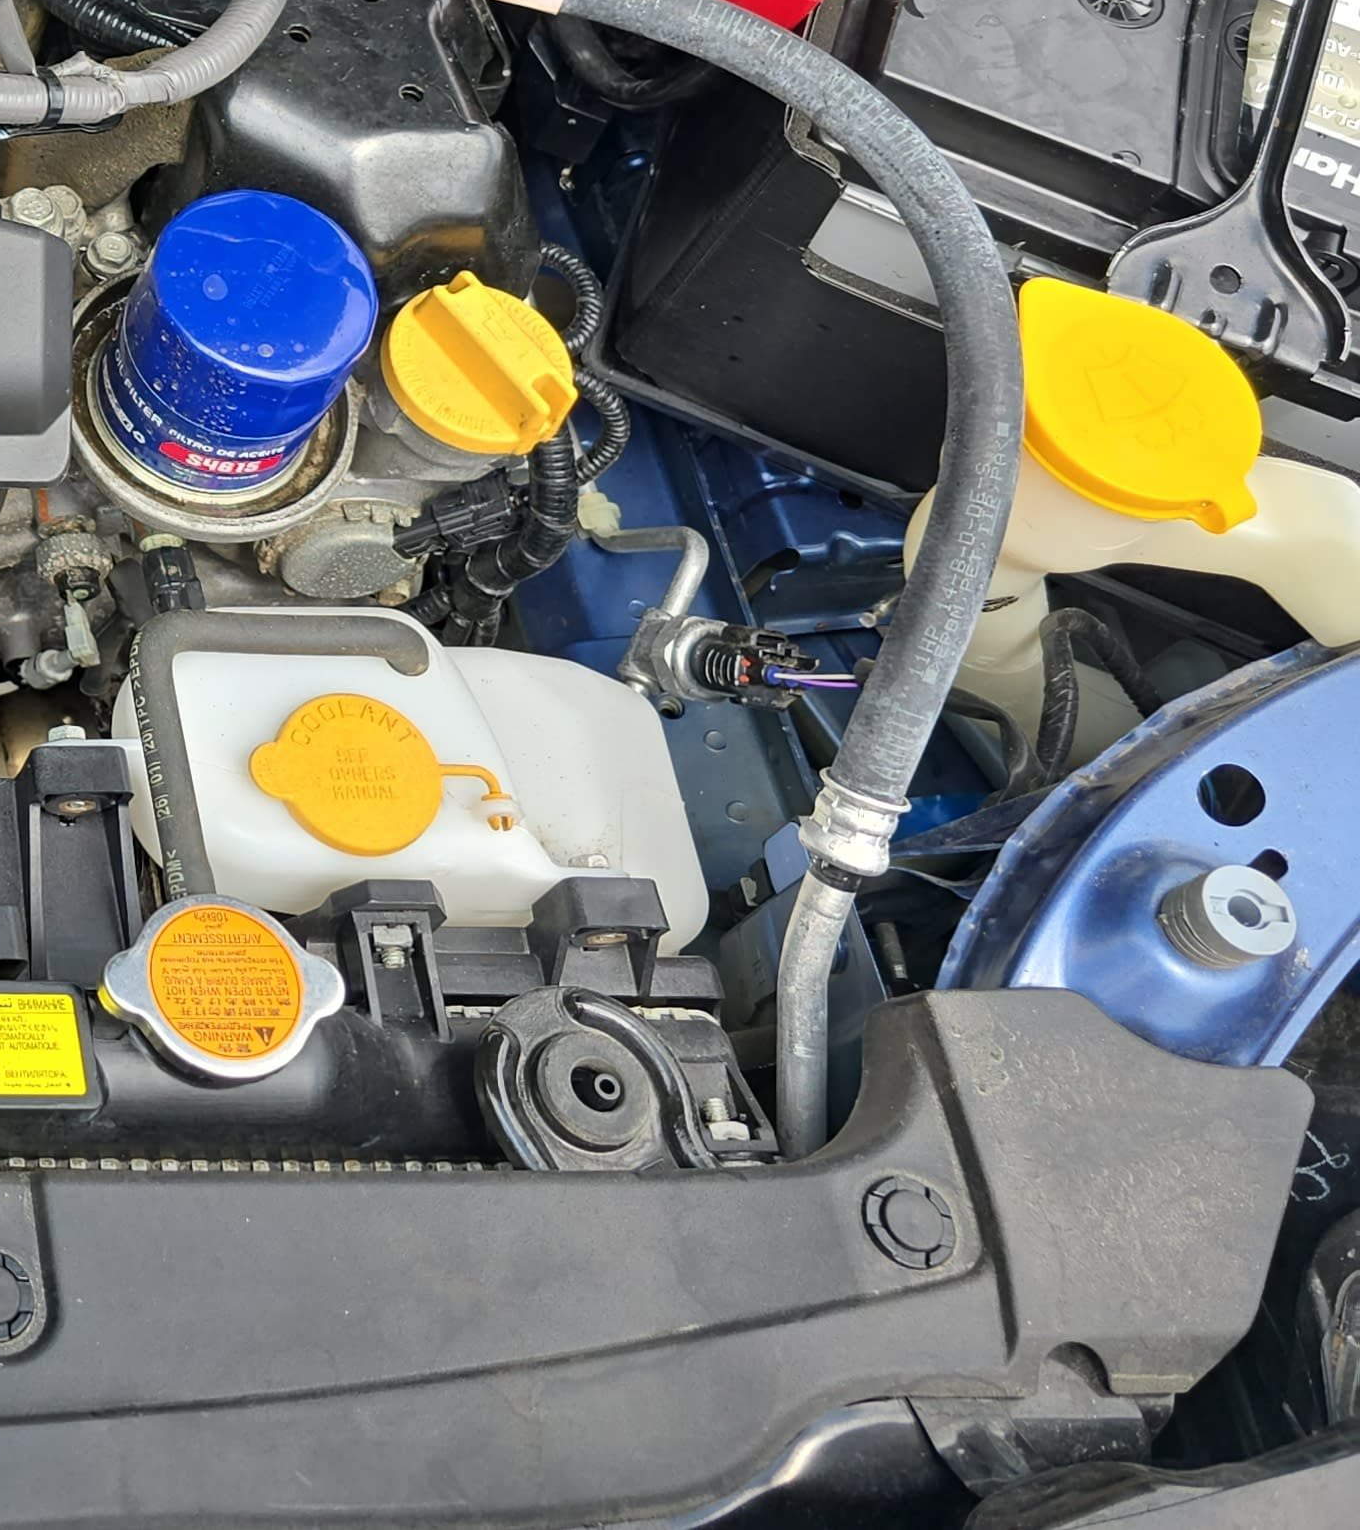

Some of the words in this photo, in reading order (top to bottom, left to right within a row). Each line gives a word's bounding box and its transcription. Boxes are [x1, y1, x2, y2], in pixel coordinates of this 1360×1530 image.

[123, 378, 164, 428] FILTER
[168, 427, 215, 454] FILTRO
[216, 448, 237, 459] DE
[289, 699, 414, 748] COOLANT
[171, 933, 262, 944] AVERTISSEMENT
[241, 976, 273, 986] JAMAIS
[276, 976, 288, 986] NE
[190, 986, 220, 996] WHEN
[224, 986, 252, 996] OPEN
[256, 986, 289, 996] NEVER
[192, 1030, 254, 1042] WARNING
